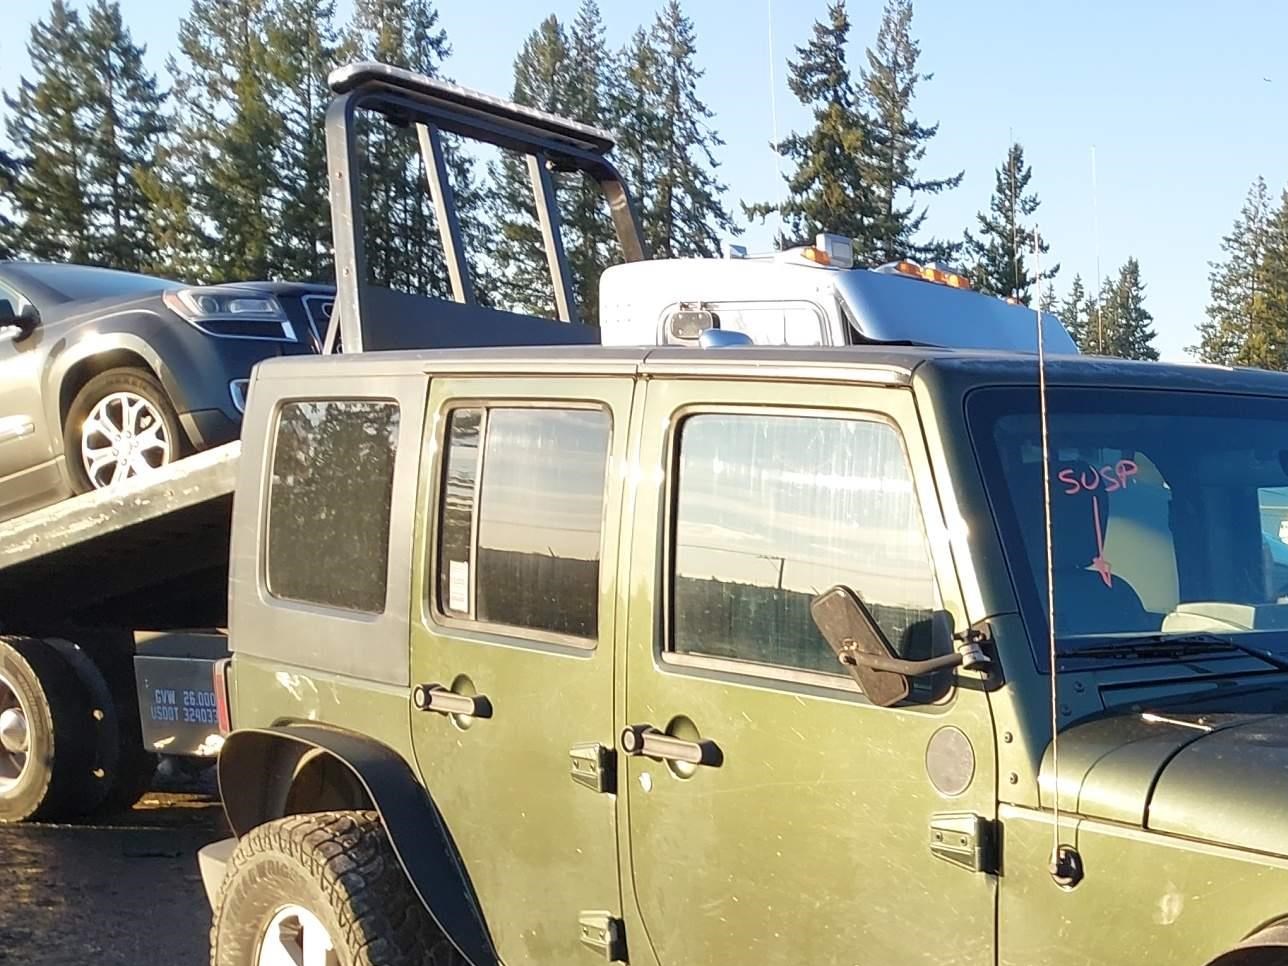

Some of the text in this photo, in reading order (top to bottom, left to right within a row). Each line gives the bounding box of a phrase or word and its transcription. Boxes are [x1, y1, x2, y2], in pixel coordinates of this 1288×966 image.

[1058, 459, 1138, 495] SUSP
[155, 689, 176, 705] GVW
[150, 704, 179, 721] USDOT
